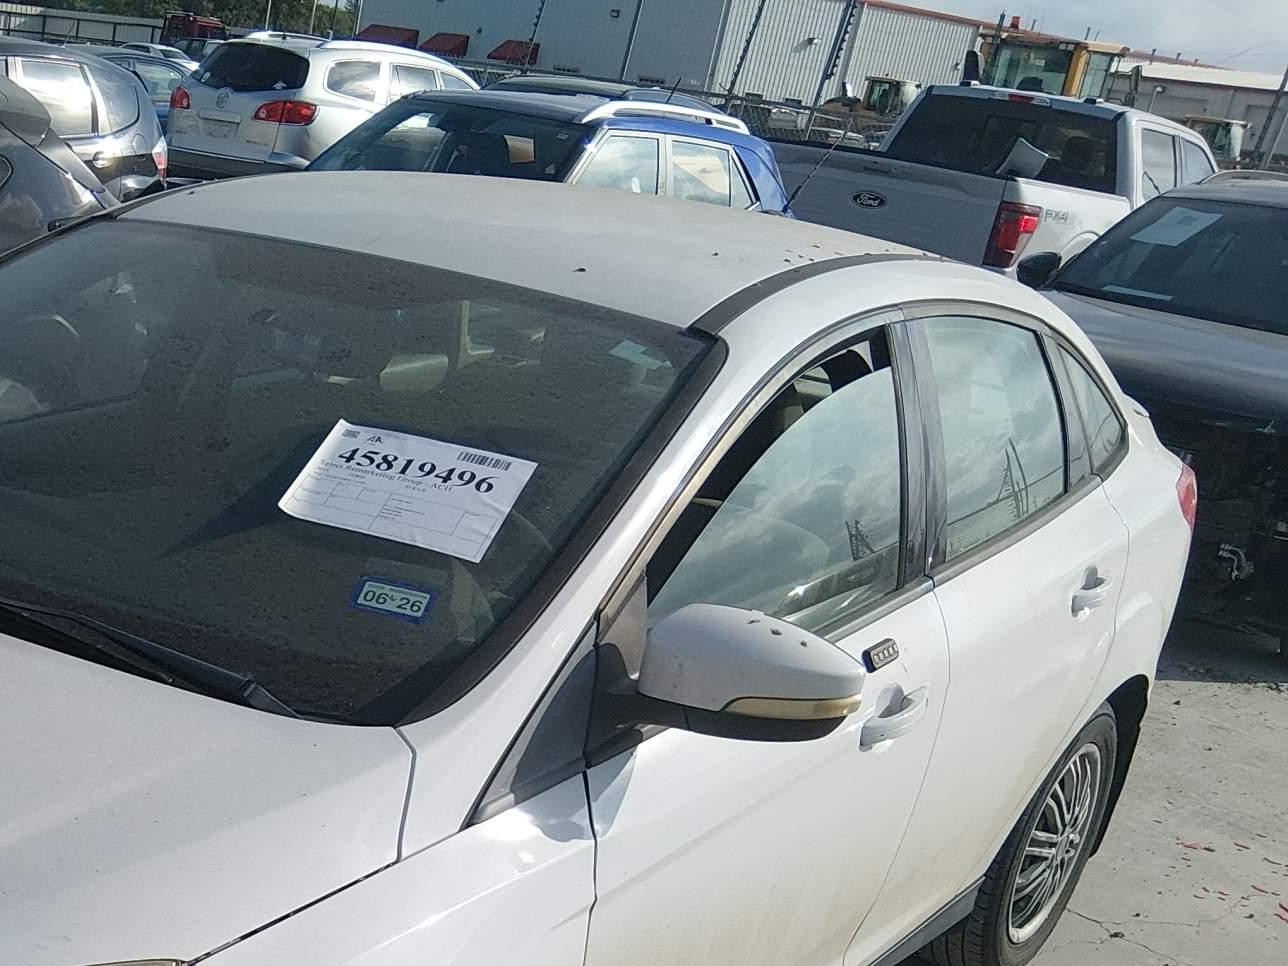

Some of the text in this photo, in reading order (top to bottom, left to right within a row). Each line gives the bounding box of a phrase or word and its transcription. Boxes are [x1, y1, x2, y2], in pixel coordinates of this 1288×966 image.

[856, 193, 882, 207] Ford
[1044, 209, 1069, 222] FX4
[337, 447, 500, 494] 45819496
[345, 463, 397, 481] Remarketing
[363, 590, 389, 605] 06
[396, 597, 424, 613] 26
